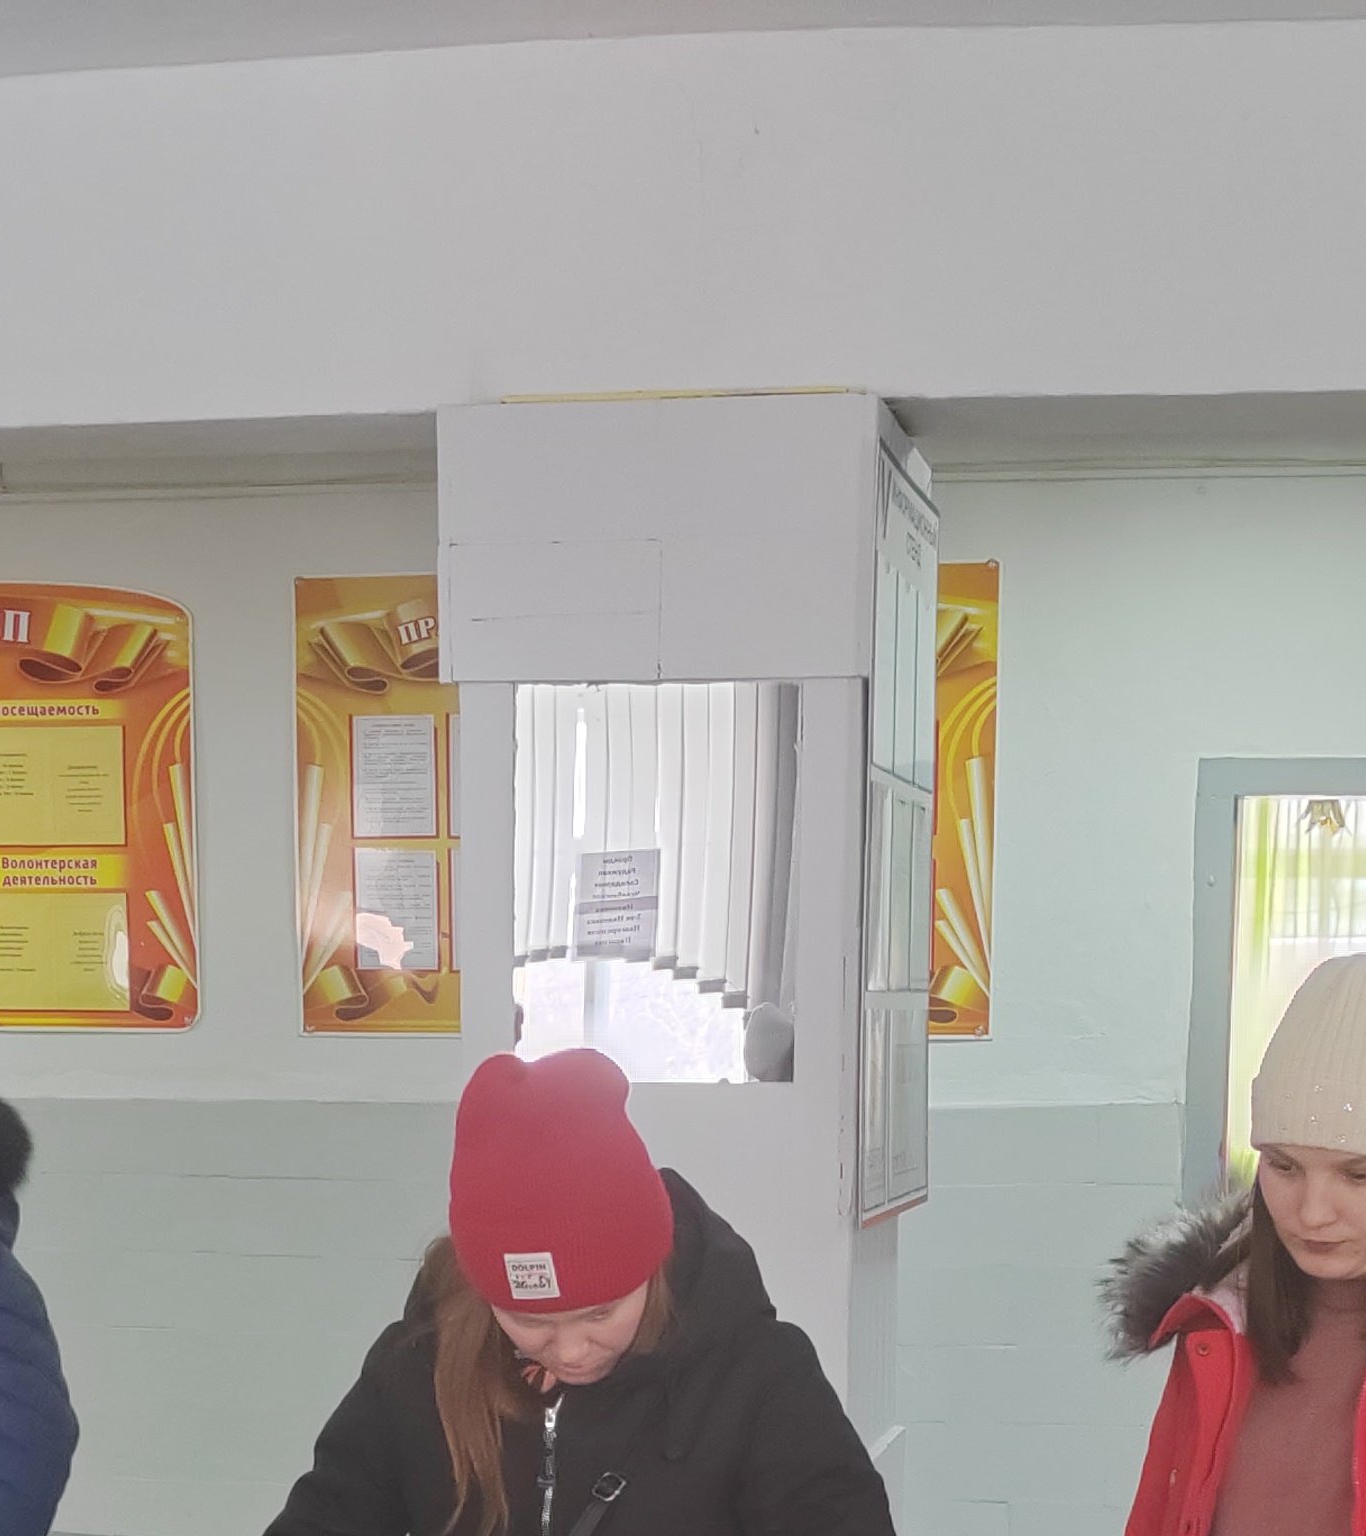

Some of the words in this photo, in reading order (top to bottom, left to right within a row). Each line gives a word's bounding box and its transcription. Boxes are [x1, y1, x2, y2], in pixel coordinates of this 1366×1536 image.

[397, 616, 438, 646] ПР
[1, 857, 98, 873] Волонтерская
[2, 875, 97, 887] деятельность
